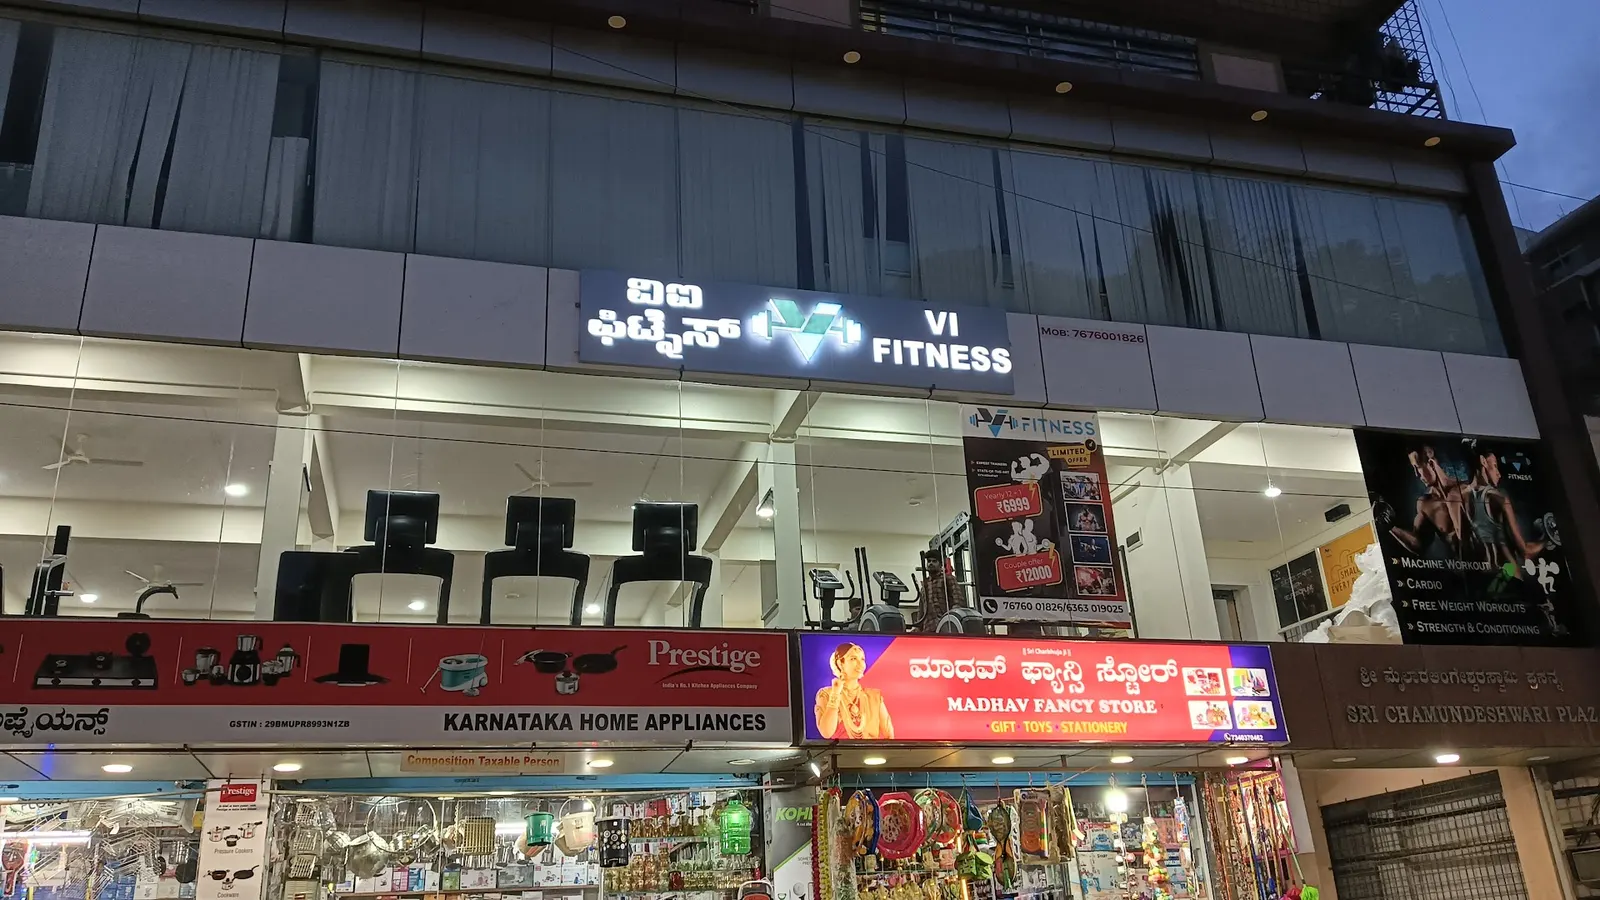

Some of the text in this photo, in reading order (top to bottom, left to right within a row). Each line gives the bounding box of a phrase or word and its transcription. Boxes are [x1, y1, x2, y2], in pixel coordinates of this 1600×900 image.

[924, 309, 958, 337] VI
[1072, 330, 1144, 343] 7676001826
[872, 337, 1012, 373] FITNESS
[1022, 418, 1095, 436] FITNESS
[984, 491, 1005, 500] Yearly
[996, 497, 1030, 514] ₹6999
[1003, 560, 1026, 570] Couple
[1401, 557, 1444, 569] MACHINE
[1015, 565, 1052, 583] ₹12000
[1332, 582, 1350, 595] EVERY
[1406, 578, 1442, 590] CARDIO
[1003, 602, 1124, 614] 76760 01826/6363 019025
[1412, 599, 1526, 613] FREE WEIGHT WORKOUTS
[1417, 620, 1540, 635] STRENGTH & CONDITIONING
[648, 640, 761, 673] Prestige
[909, 655, 1006, 682] ಮಾಧವ್
[947, 697, 1157, 714] MADHAV FANCY STORE
[0, 706, 109, 738] ಪ್ಲೈಯನ್ಸ್
[443, 712, 766, 731] KARNATAKA HOME APPLIANCES
[1346, 705, 1378, 723] SRI
[1385, 706, 1552, 723] CHAMUNDESHWARI
[991, 720, 1127, 733] GIFT TOYS STATIONERY
[407, 755, 560, 767] Composition Taxable Person
